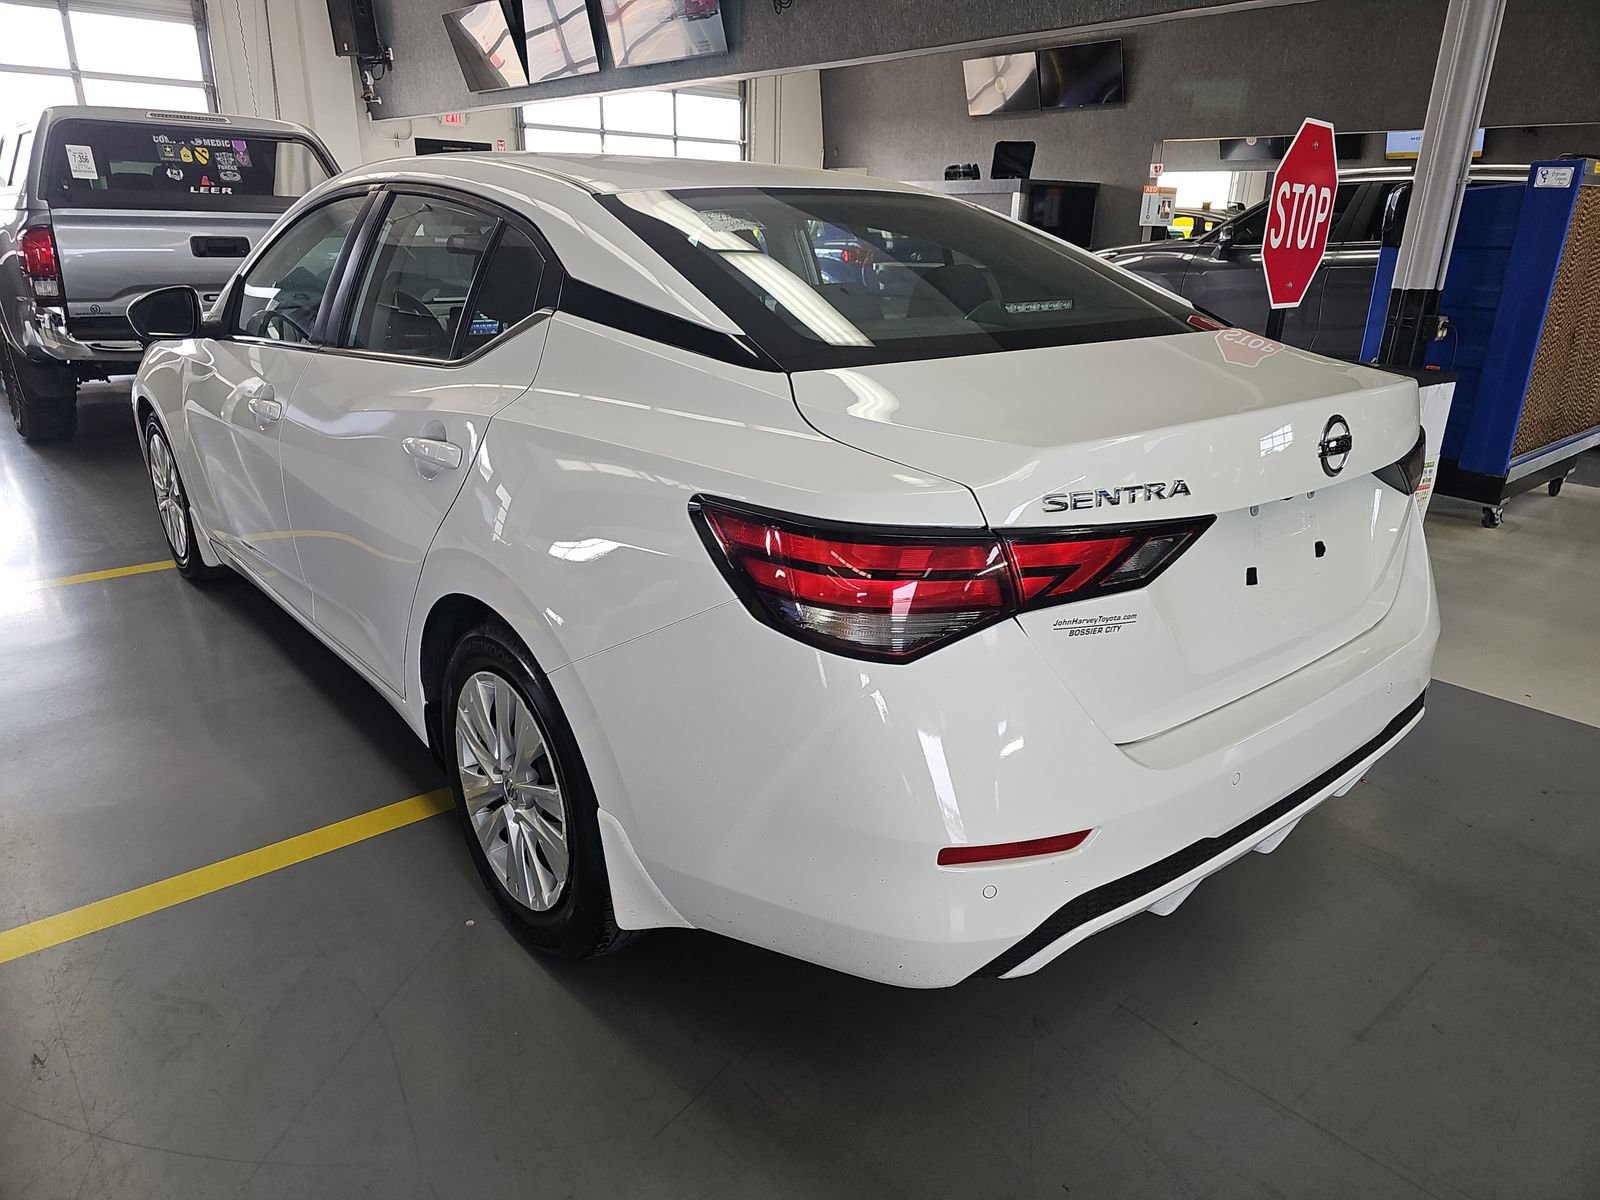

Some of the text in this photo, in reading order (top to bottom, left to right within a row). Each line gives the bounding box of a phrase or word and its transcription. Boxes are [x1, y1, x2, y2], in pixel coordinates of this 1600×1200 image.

[203, 138, 231, 148] MEDIC
[190, 186, 233, 195] LEER
[1144, 185, 1158, 193] AED
[1269, 180, 1331, 250] STOP
[1041, 479, 1192, 513] SENTRA
[1052, 613, 1138, 627] JohnHarveyToyota.com
[1068, 625, 1122, 637] BOSSIER CITY
